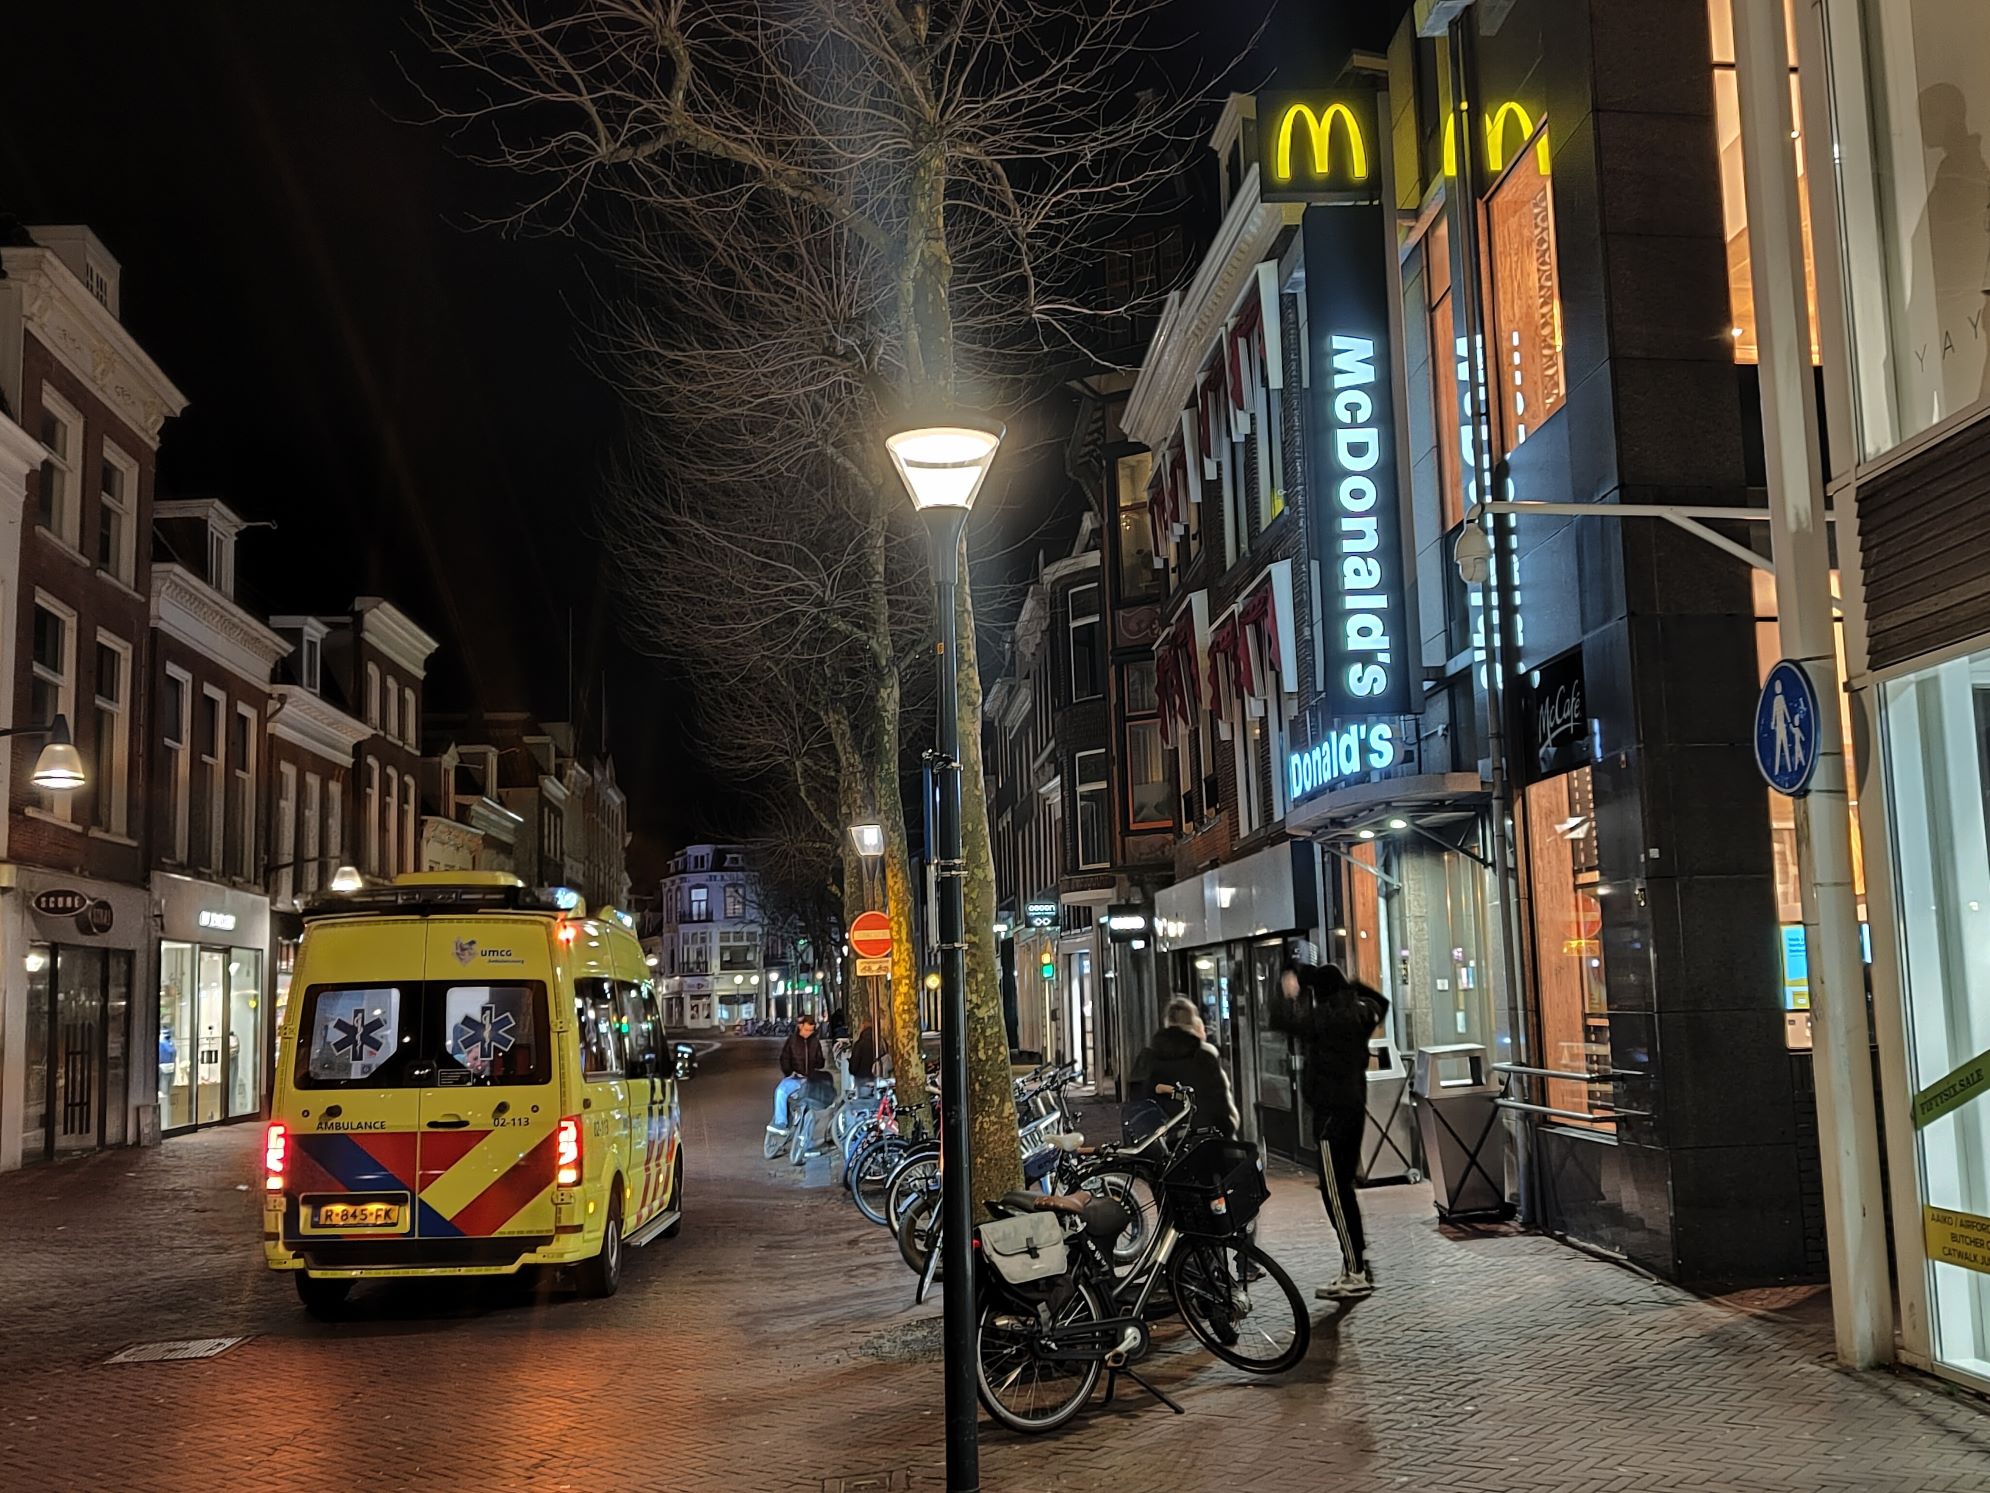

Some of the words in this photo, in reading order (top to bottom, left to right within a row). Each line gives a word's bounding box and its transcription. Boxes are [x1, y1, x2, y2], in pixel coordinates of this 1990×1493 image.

[1330, 335, 1392, 698] McDonald's
[1539, 680, 1581, 747] McCafé
[1958, 1067, 1985, 1092] SALE
[316, 1121, 386, 1131] AMBULANCE
[493, 1117, 530, 1127] 02-113
[1943, 1246, 1979, 1263] CATWALK
